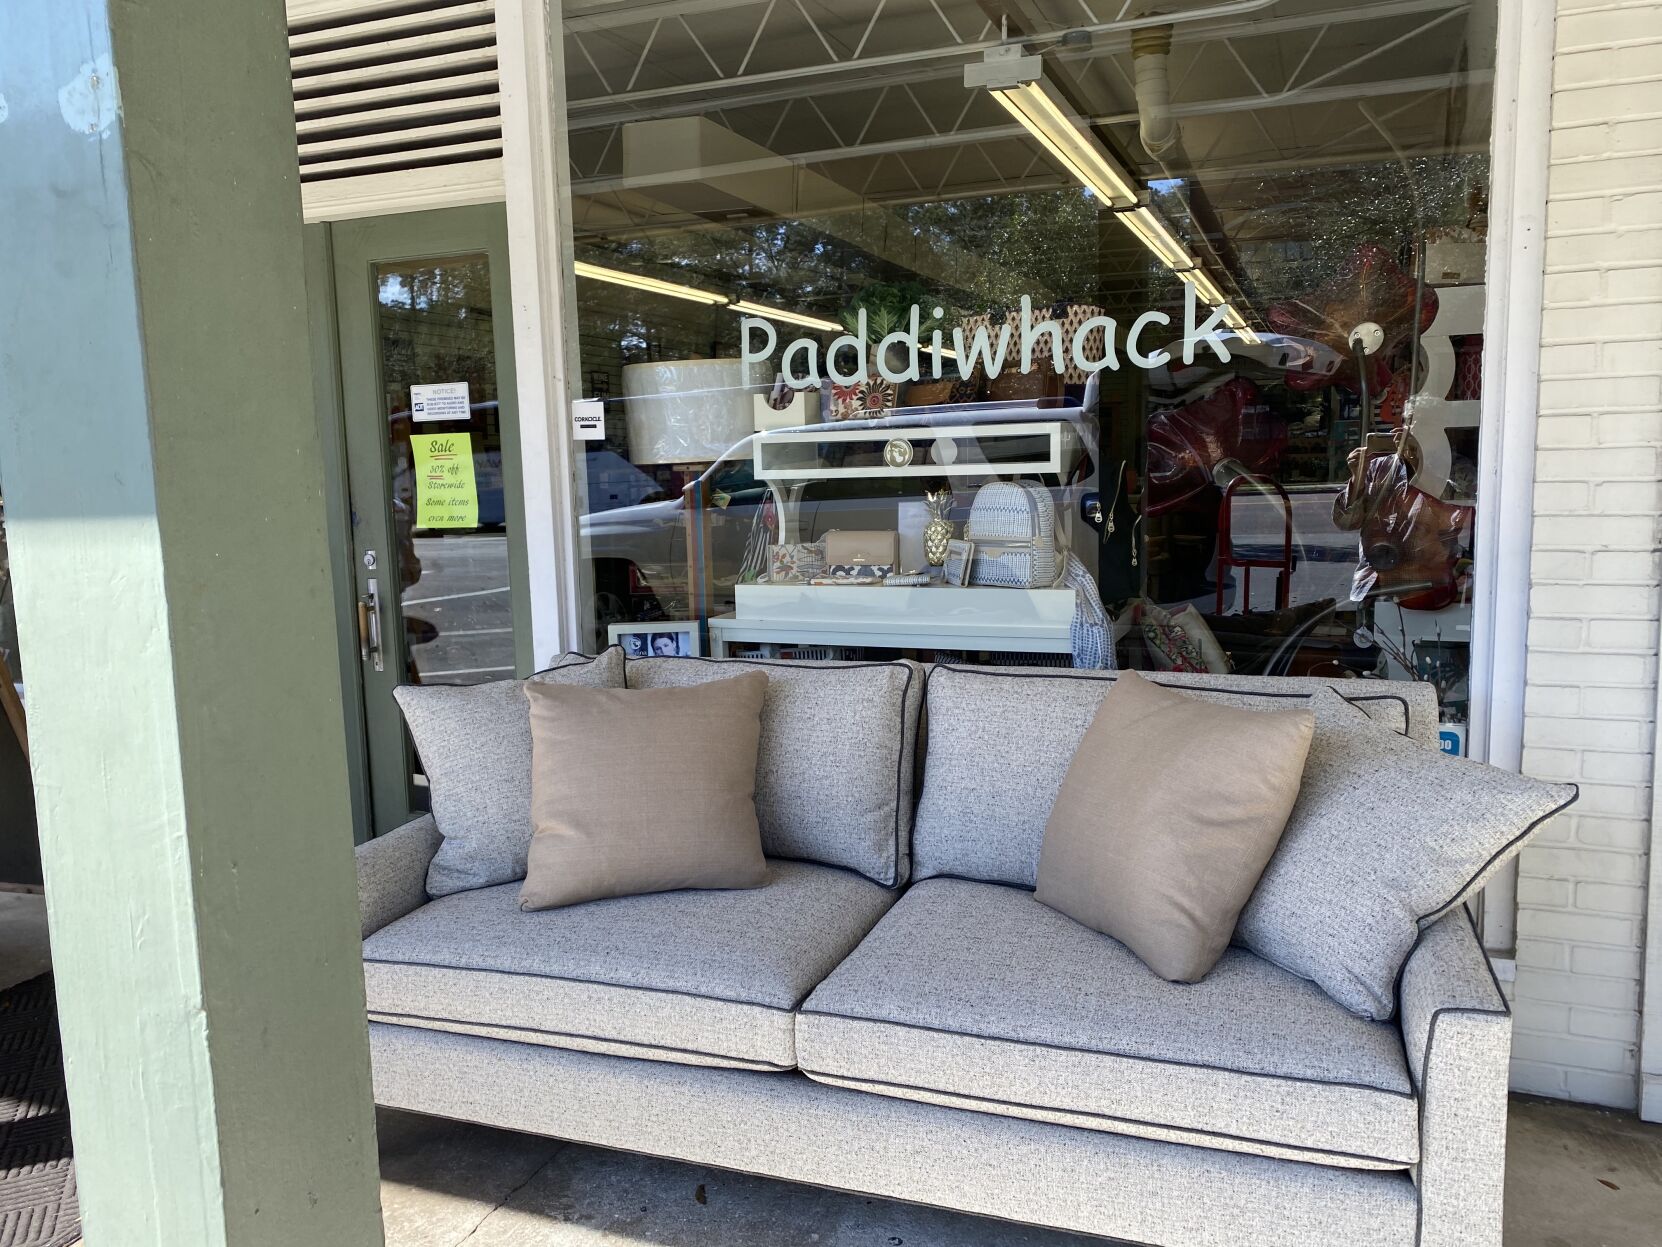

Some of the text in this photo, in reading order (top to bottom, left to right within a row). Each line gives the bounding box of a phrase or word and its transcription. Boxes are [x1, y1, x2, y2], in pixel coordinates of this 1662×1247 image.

[740, 281, 1232, 390] Paddiwhack
[429, 439, 455, 453] Sale
[448, 464, 460, 475] off
[427, 480, 465, 489] Storewide
[426, 497, 469, 506] Some items
[447, 514, 467, 522] more
